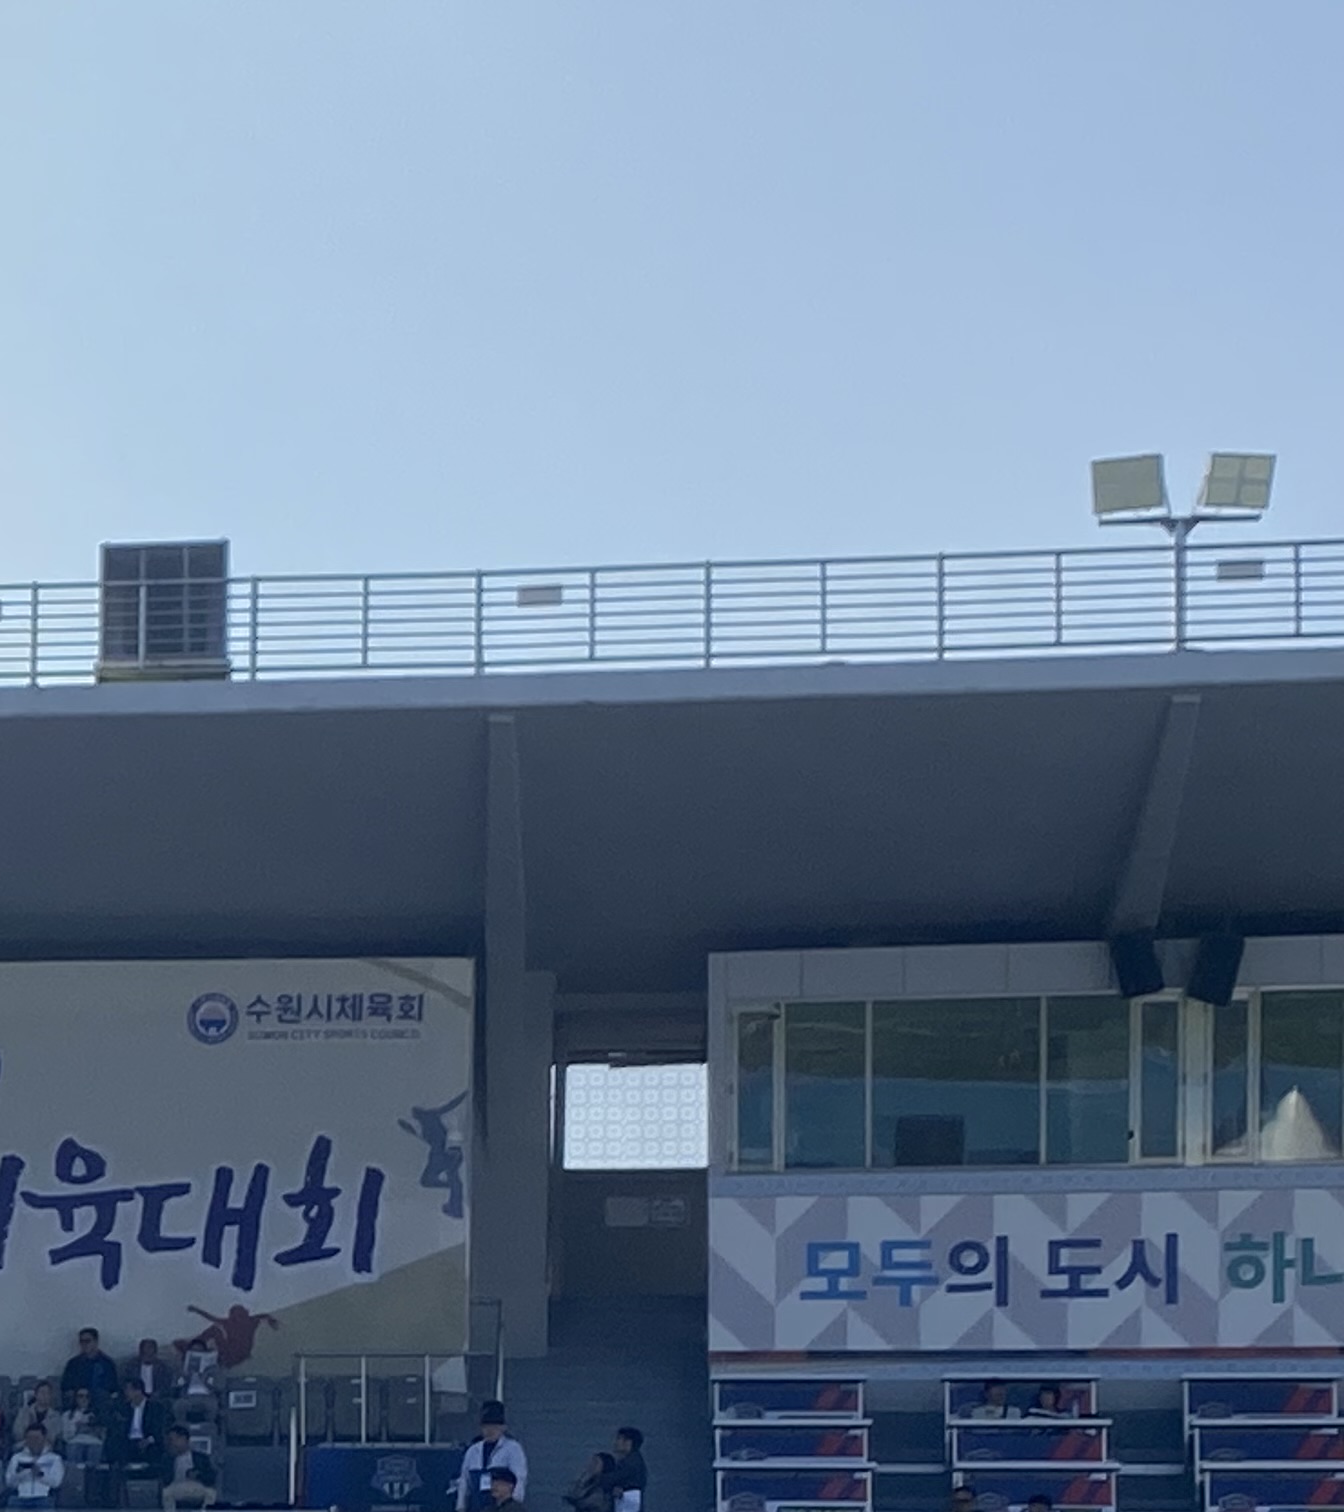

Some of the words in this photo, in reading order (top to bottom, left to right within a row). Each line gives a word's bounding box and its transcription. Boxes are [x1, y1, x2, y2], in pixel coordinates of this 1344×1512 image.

[245, 993, 425, 1024] 수원시체육회
[799, 1234, 1010, 1308] 모두의
[1039, 1232, 1180, 1305] 도시
